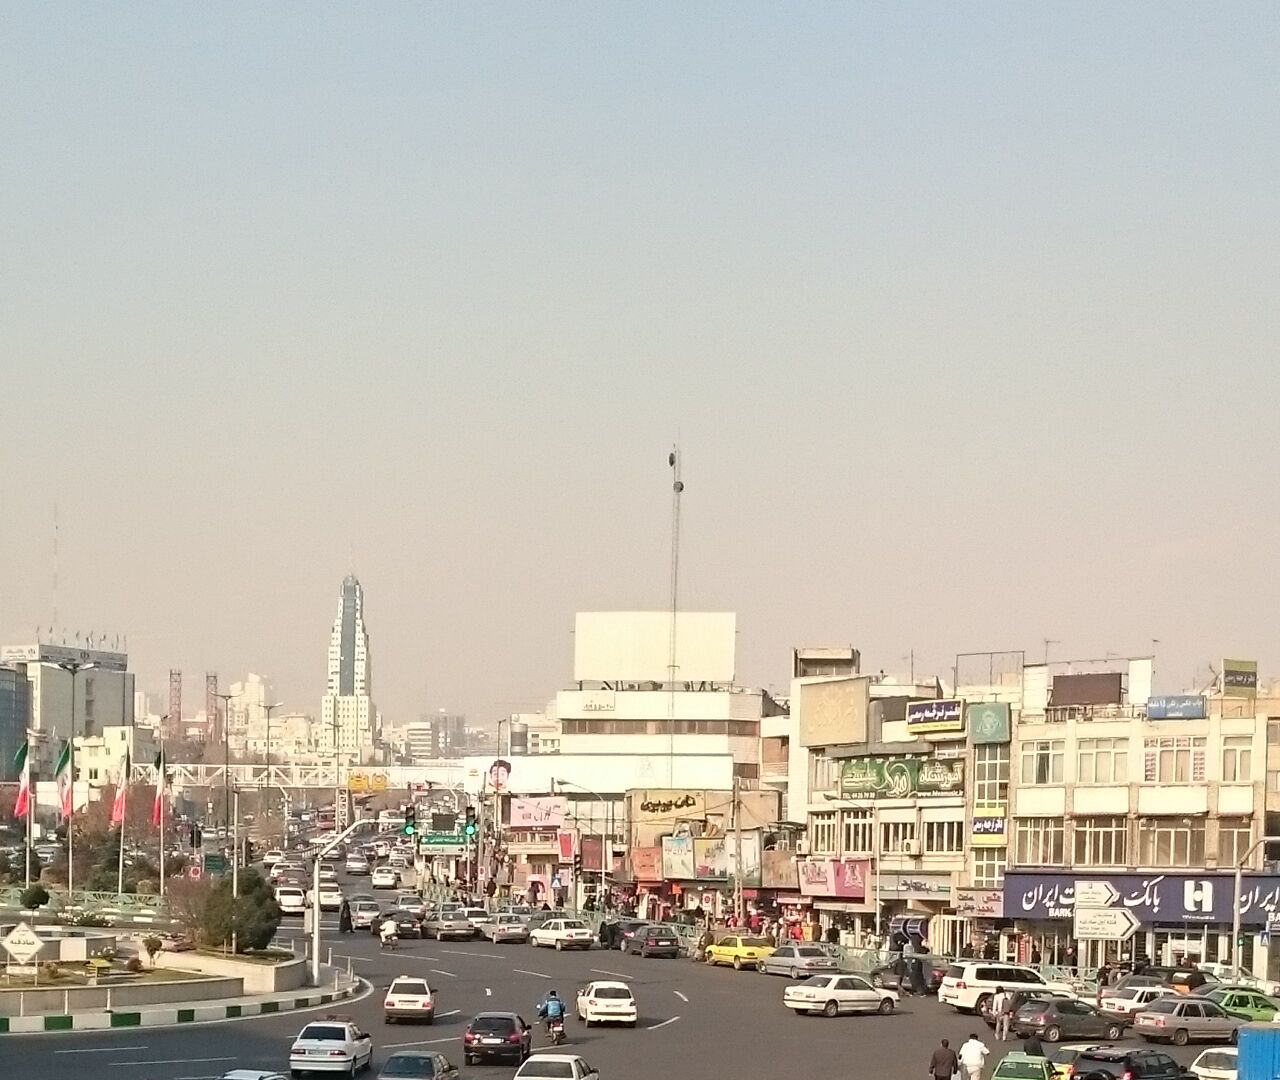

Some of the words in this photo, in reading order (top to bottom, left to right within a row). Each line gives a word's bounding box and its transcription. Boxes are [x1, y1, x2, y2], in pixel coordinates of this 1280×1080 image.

[919, 762, 964, 788] آموزشگاه
[1022, 884, 1059, 911] ایران
[1124, 876, 1165, 913] بانک
[1238, 886, 1280, 914] ایران
